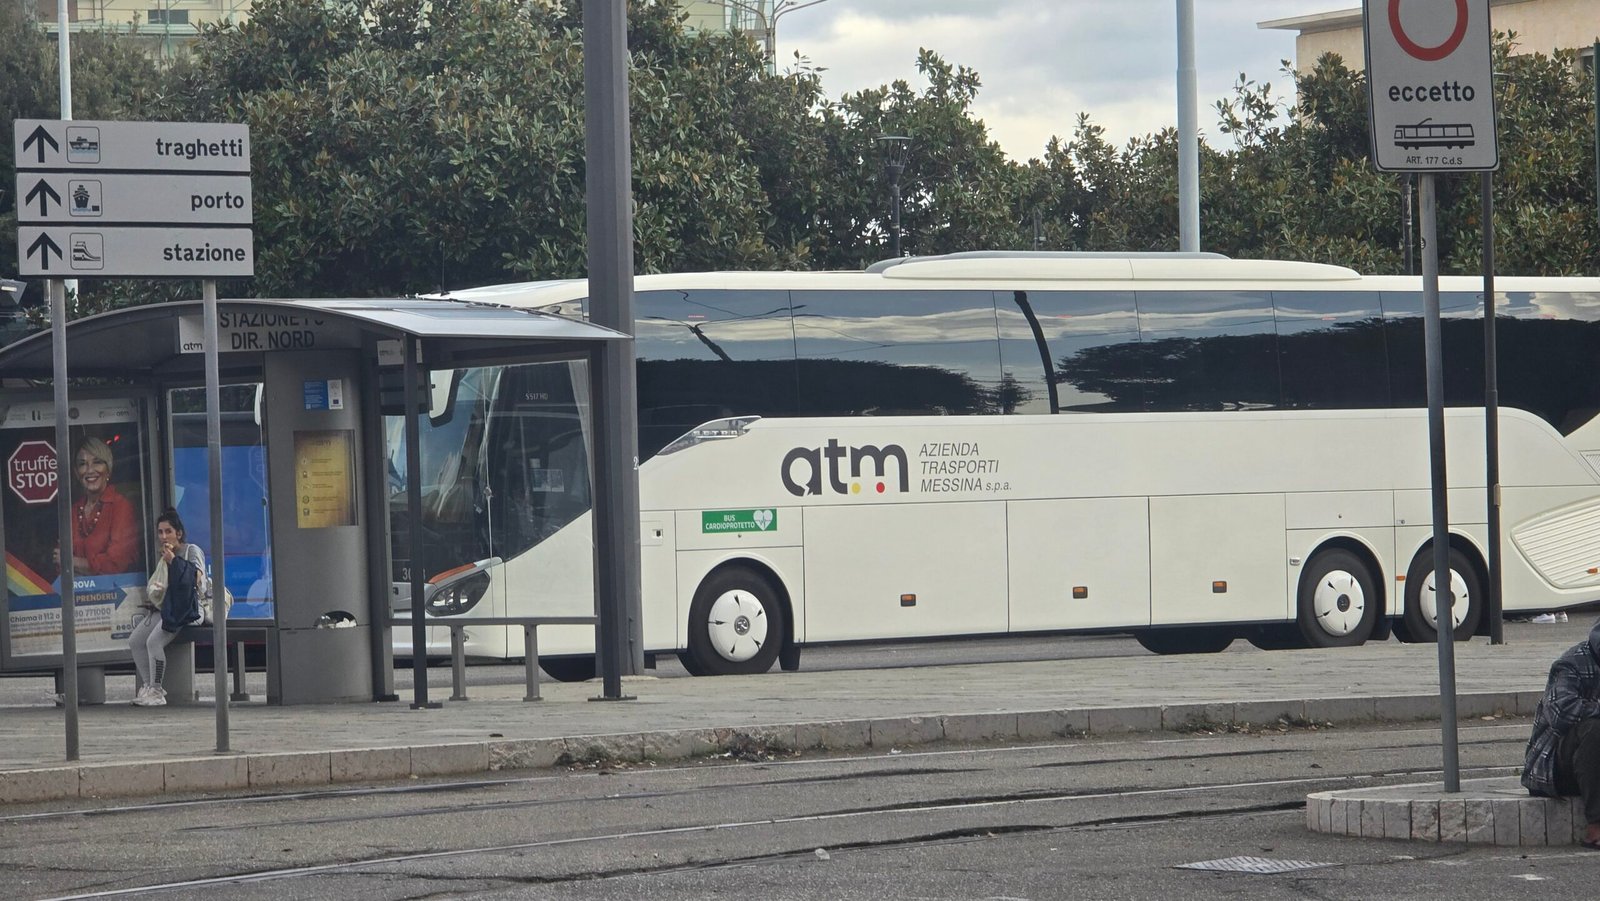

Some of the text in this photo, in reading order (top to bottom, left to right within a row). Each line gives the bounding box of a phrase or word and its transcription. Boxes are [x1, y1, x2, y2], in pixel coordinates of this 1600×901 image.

[1388, 81, 1475, 102] eccetto
[156, 138, 243, 160] traghetti
[1406, 156, 1463, 165] ART. 177 C.d.S
[191, 191, 245, 211] porto
[163, 242, 246, 261] stazione
[183, 342, 203, 351] atm
[231, 330, 315, 350] DIR. NORD
[919, 442, 980, 457] AZIENDA
[13, 455, 58, 472] truffe
[781, 438, 910, 497] atm
[920, 460, 999, 475] TRASPORTI
[16, 471, 58, 489] STOP
[920, 478, 1012, 493] MESSINA s.p.a.
[705, 521, 755, 530] CARDIOPROTETTO
[723, 514, 736, 522] BUS
[73, 580, 96, 589] ROVA
[10, 615, 37, 623] Chiama
[44, 612, 54, 620] 112
